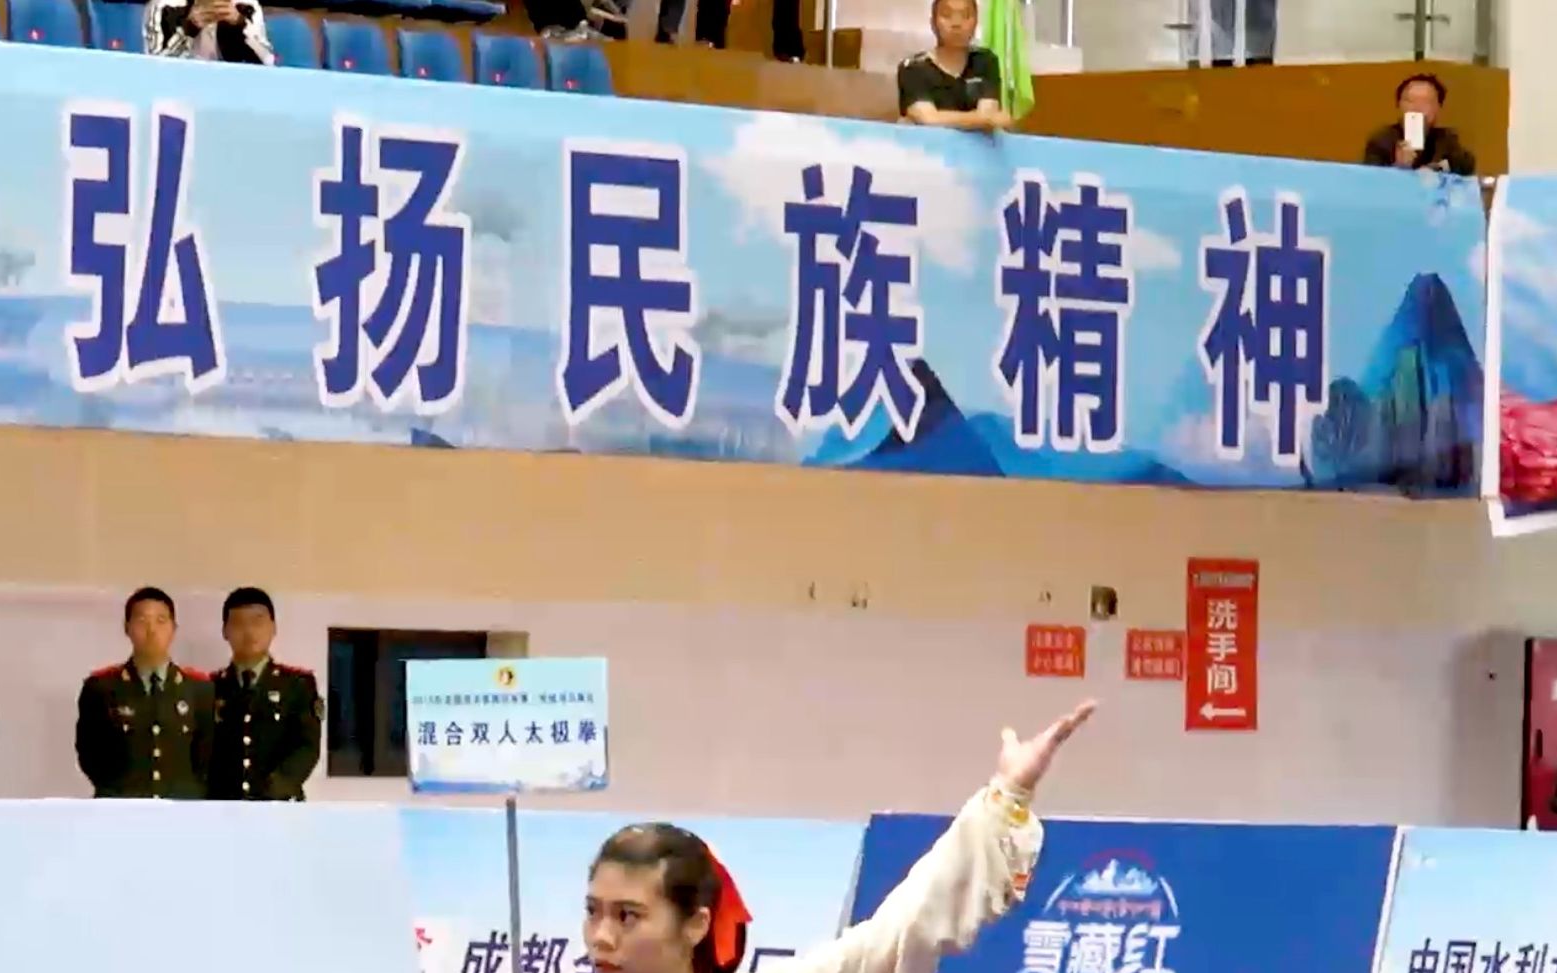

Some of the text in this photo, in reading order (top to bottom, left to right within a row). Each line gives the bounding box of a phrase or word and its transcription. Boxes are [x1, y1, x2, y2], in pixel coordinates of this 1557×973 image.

[1206, 598, 1238, 694] 洗手间
[417, 718, 597, 747] 混合双人太极拳
